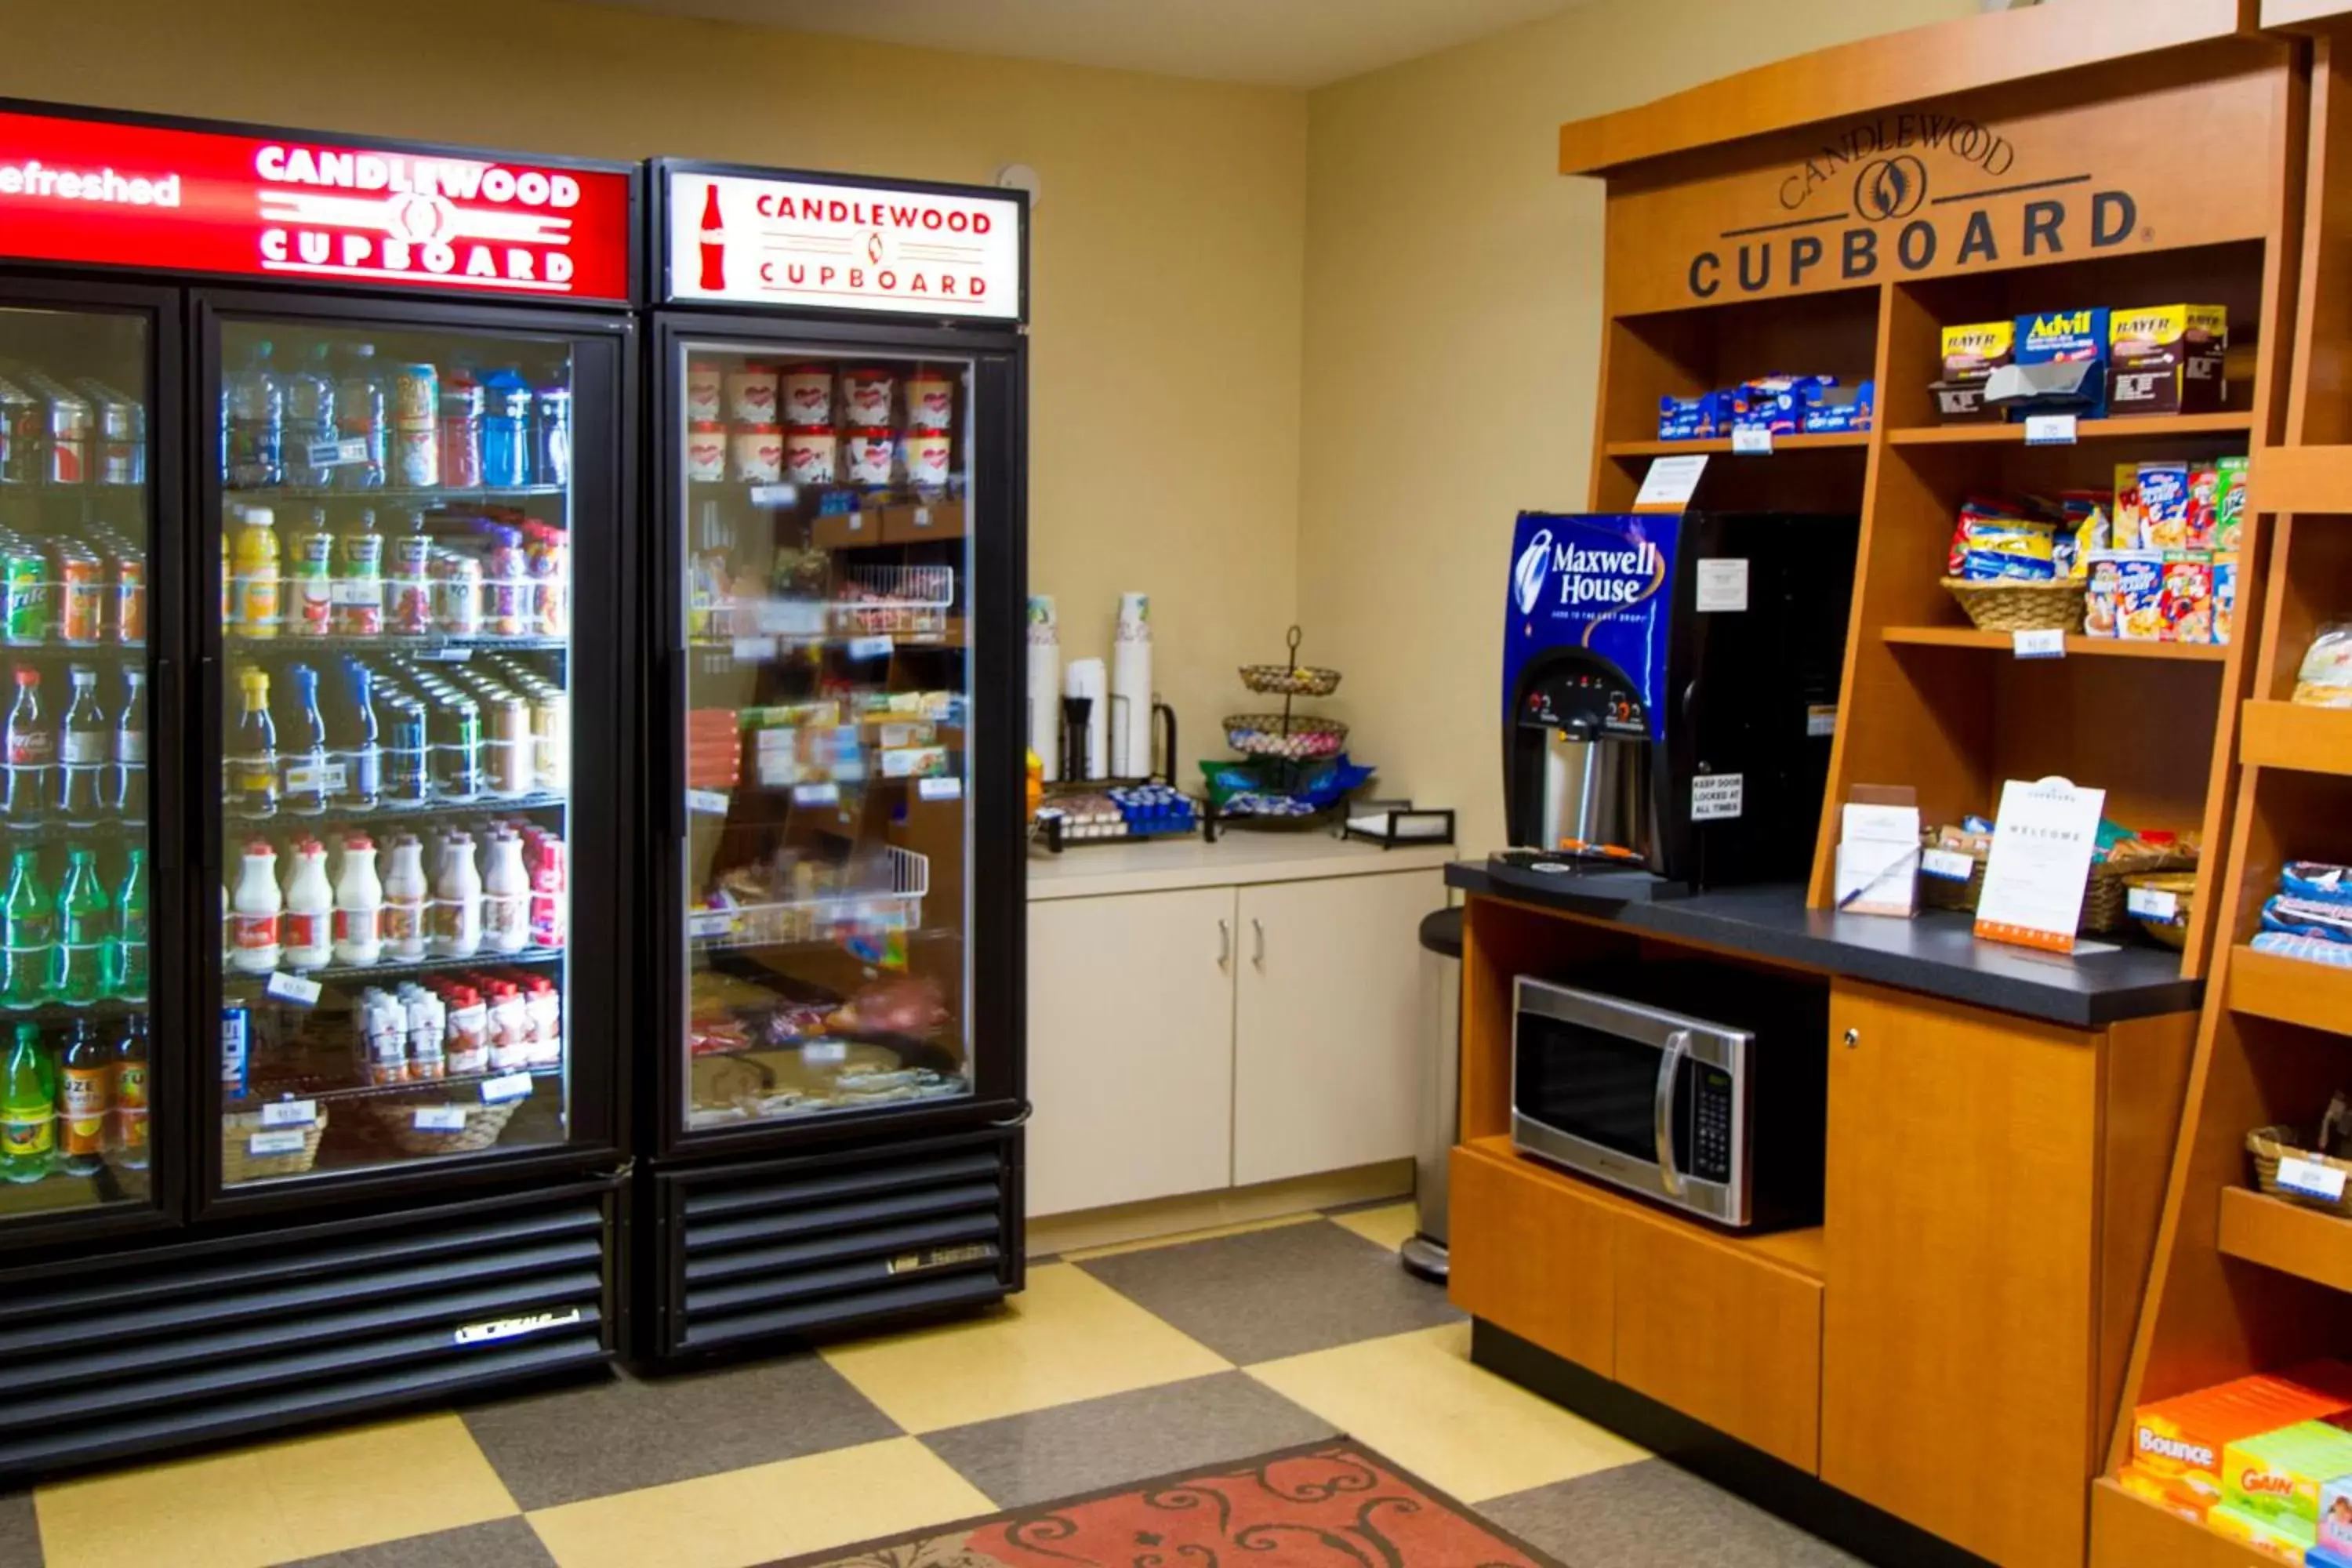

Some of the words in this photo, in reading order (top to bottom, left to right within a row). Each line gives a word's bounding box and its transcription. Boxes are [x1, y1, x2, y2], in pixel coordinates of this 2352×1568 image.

[1779, 112, 2013, 210] CANDLEWOOD
[256, 146, 581, 208] CANDLEWOOD
[757, 194, 992, 235] CANDLEWOOD
[260, 229, 574, 283] CUPBOARD
[1689, 190, 2137, 298] CUPBOARD
[760, 263, 986, 296] CUPBOARD
[2028, 311, 2091, 339] Advil
[2118, 318, 2170, 333] BAYER
[1947, 334, 1995, 349] BAYER
[1552, 542, 1656, 575] Maxwell
[1561, 574, 1640, 604] House
[1695, 791, 1727, 800] LOCKED
[1730, 789, 1739, 798] AT
[1696, 804, 1709, 813] ALL
[1713, 802, 1737, 811] TIMES
[2009, 825, 2080, 841] WELCOME
